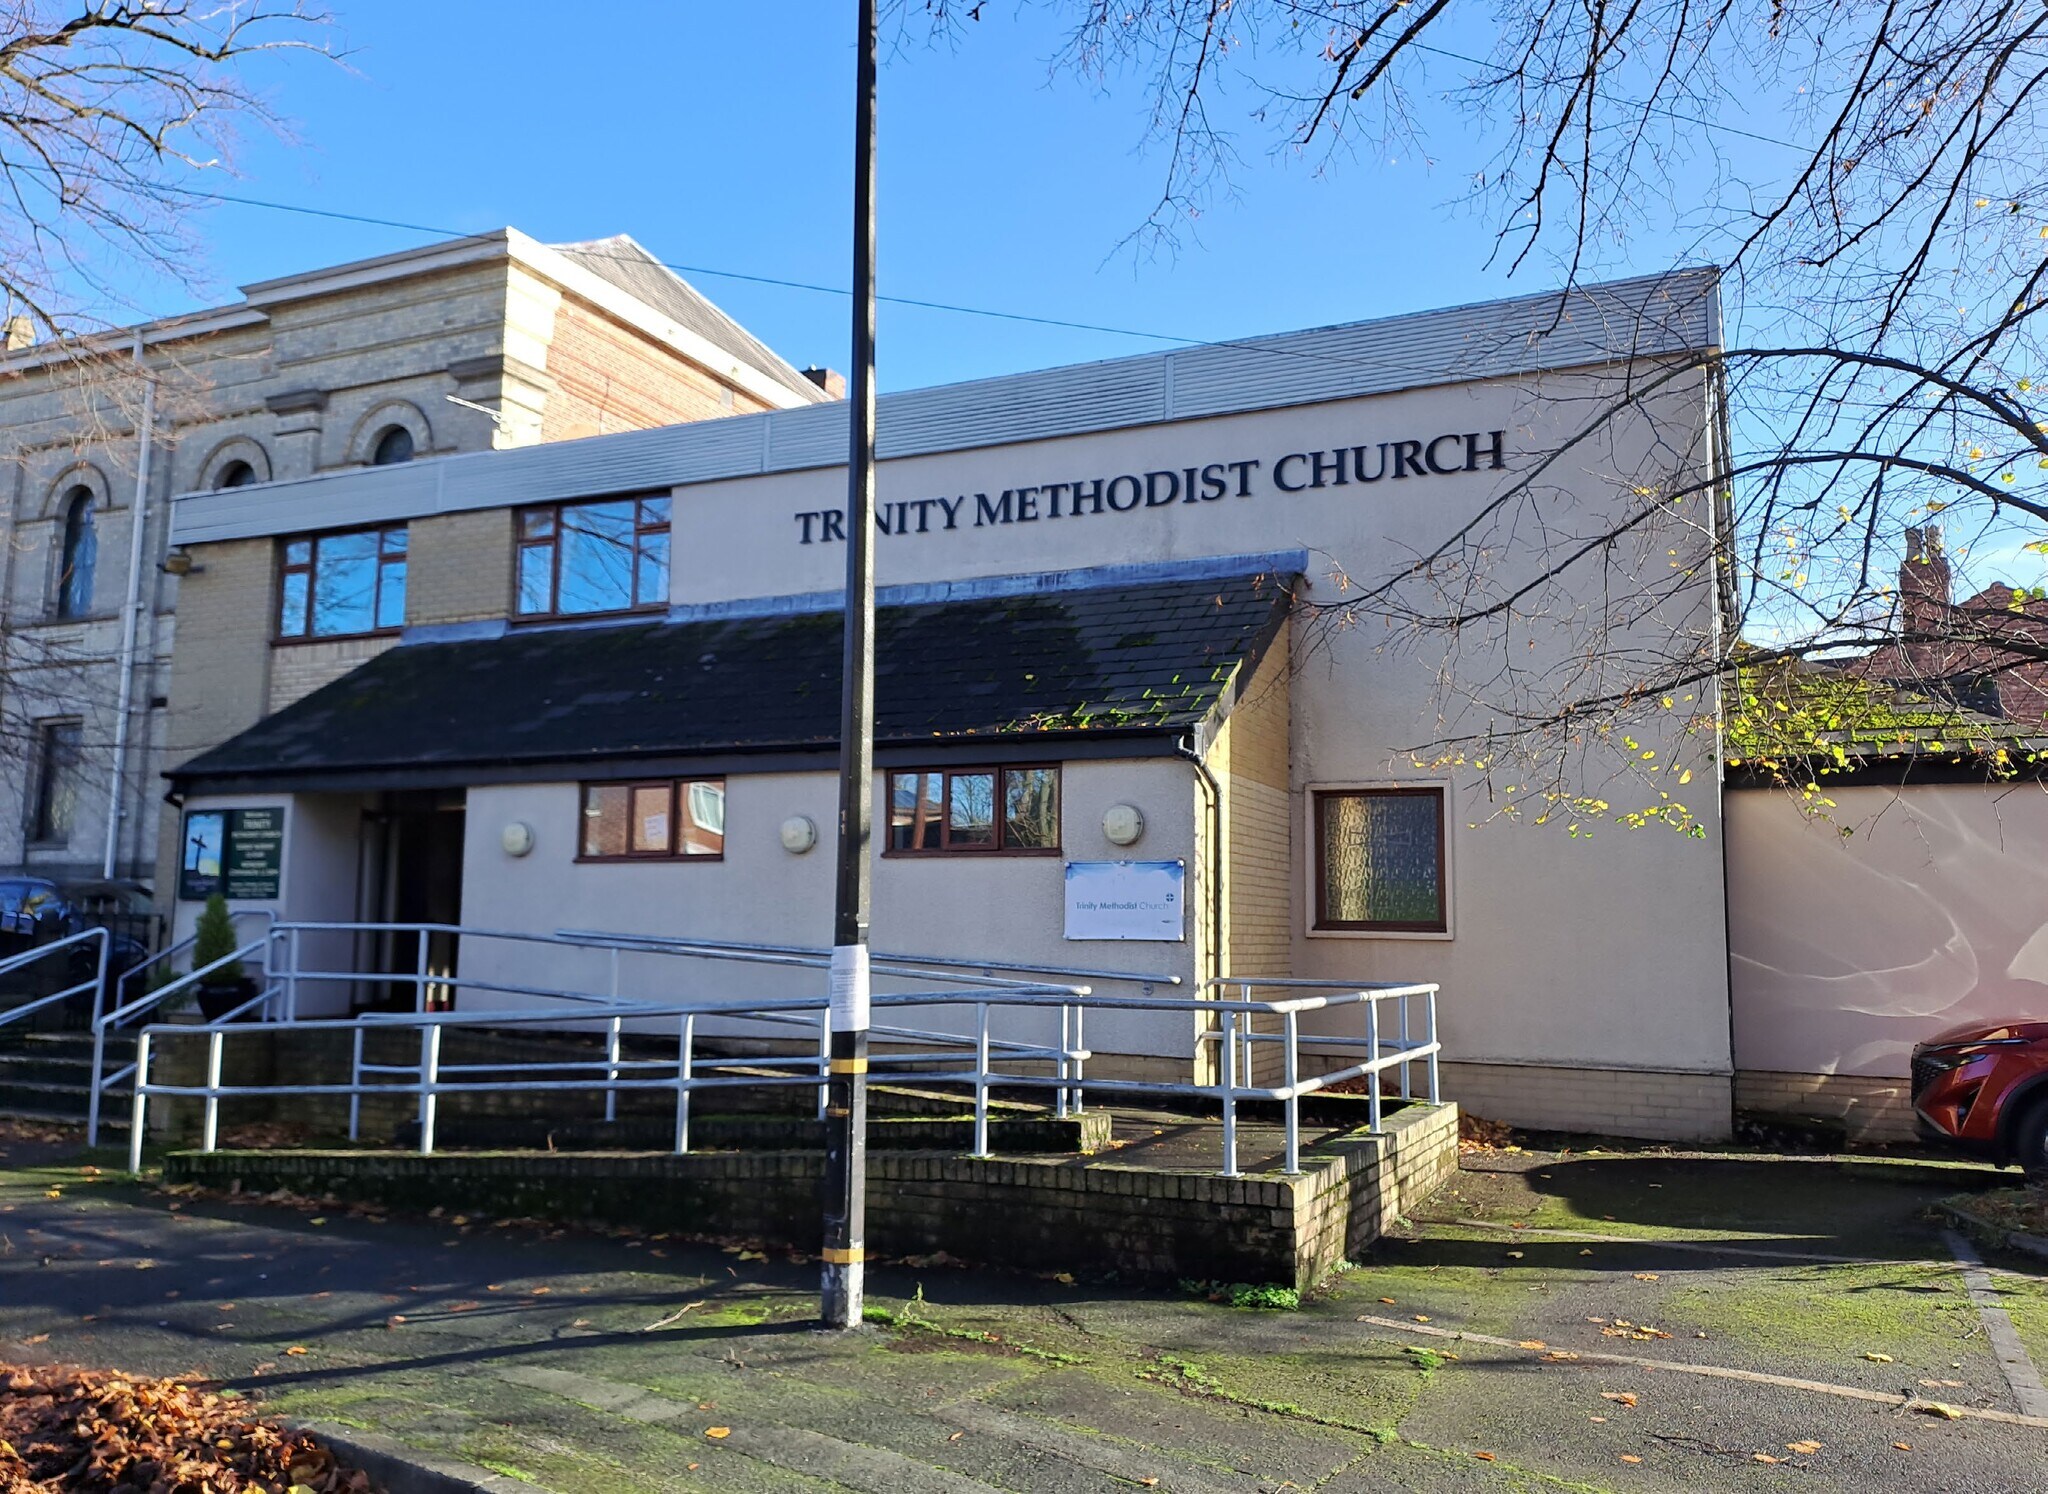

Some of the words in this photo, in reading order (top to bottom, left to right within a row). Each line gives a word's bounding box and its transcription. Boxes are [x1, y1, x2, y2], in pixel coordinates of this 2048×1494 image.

[794, 495, 964, 544] TRNITY
[973, 459, 1259, 526] METHODIST
[1273, 430, 1506, 492] CHURCH
[1076, 902, 1097, 911] Trinity
[1099, 902, 1137, 910] Methodist
[1139, 902, 1169, 910] Church
